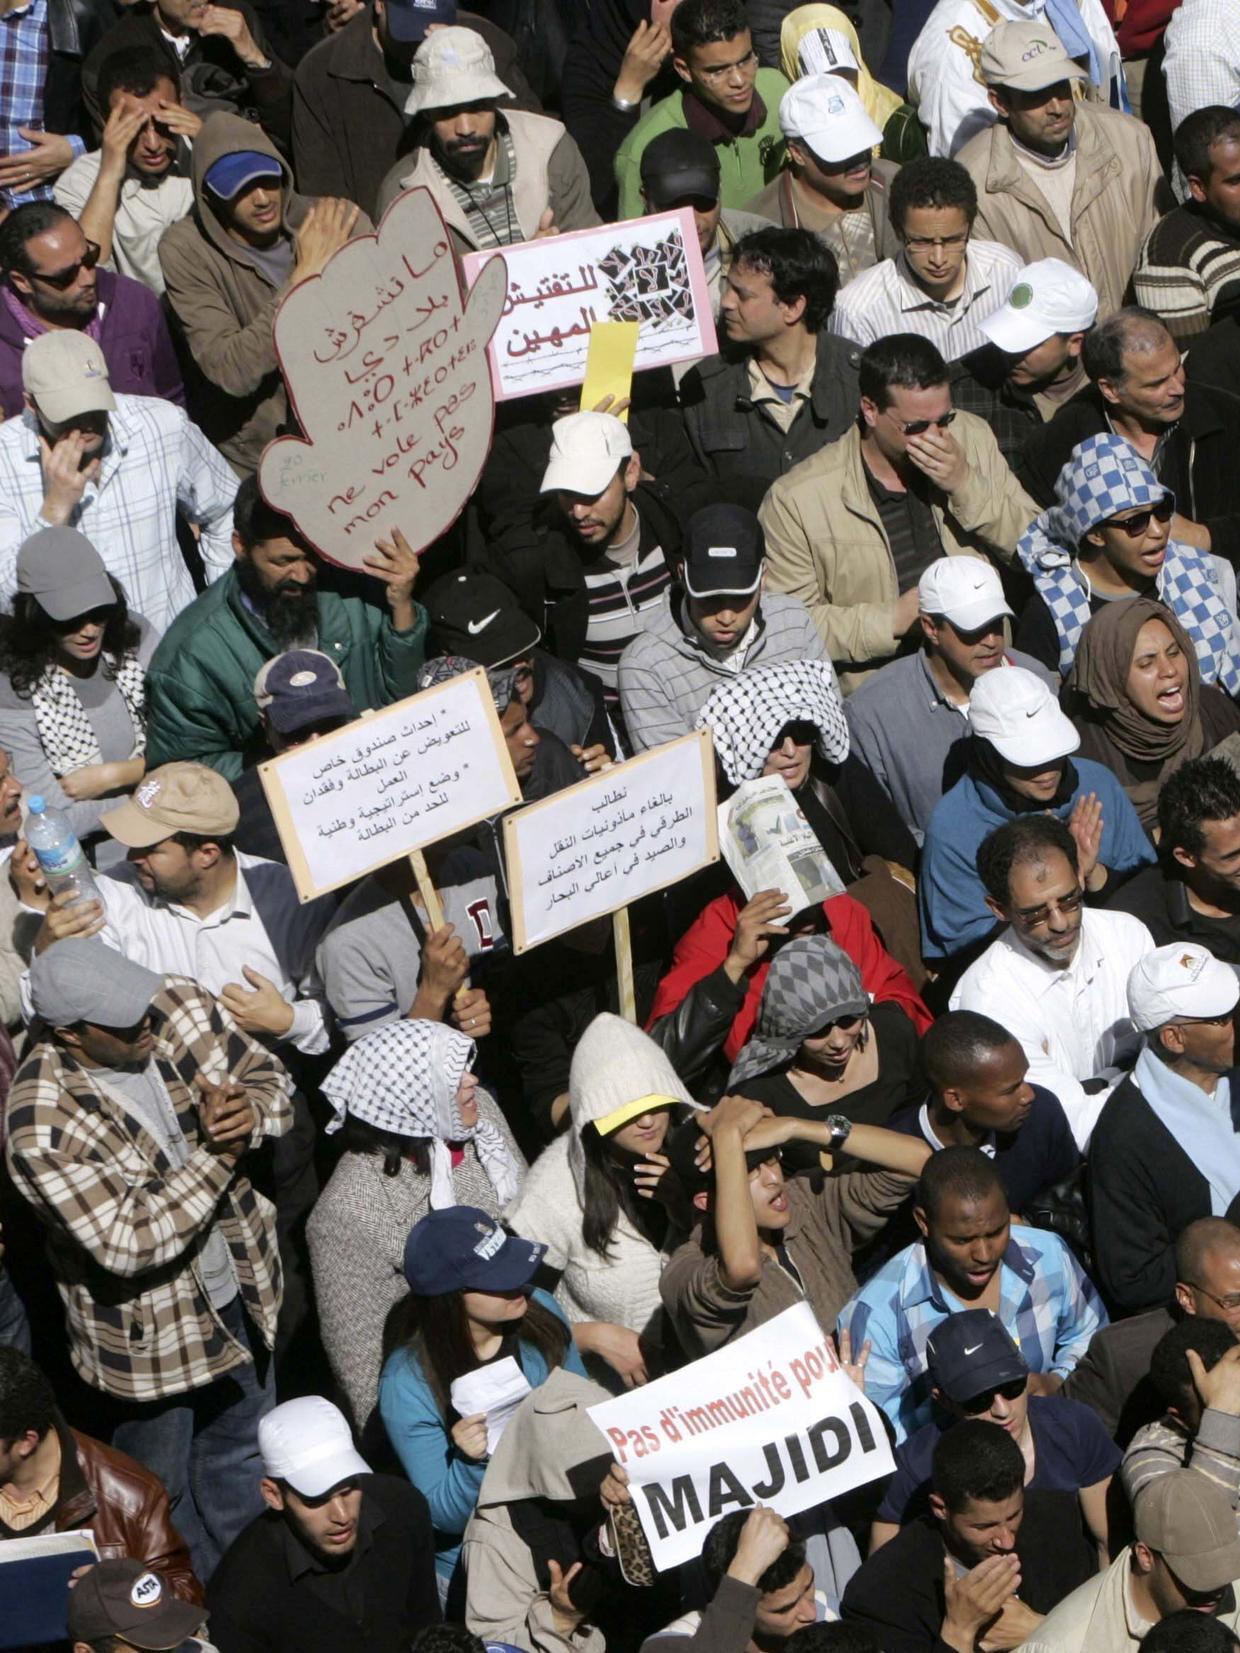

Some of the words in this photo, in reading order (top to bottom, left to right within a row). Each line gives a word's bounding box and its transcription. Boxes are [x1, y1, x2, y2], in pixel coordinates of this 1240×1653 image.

[501, 264, 598, 316] للتفتيش
[507, 305, 597, 357] المهين
[327, 485, 366, 514] ne
[371, 434, 422, 475] vole
[433, 381, 476, 433] pas
[344, 490, 399, 535] mon
[408, 425, 465, 489] pays
[351, 735, 397, 764] صندوق
[417, 720, 471, 755] للتعويض
[312, 754, 346, 780] خاص
[347, 757, 388, 781] البطالة
[392, 749, 411, 767] عن
[302, 778, 344, 806] وفقدان
[376, 769, 409, 794] العمل
[428, 768, 460, 794] وضع
[425, 792, 449, 814] للحد
[591, 786, 628, 813] نطالب
[317, 816, 356, 839] وطنية
[357, 817, 397, 843] البطالة
[401, 810, 420, 826] من
[549, 835, 577, 860] النقل
[628, 825, 646, 848] في
[644, 836, 687, 862] والصيد
[594, 840, 625, 866] جميع
[622, 852, 640, 875] في
[545, 882, 580, 911] البحار
[606, 1423, 662, 1464] Pas
[659, 1360, 792, 1444] d'immunité
[641, 1401, 877, 1541] MAJIDI
